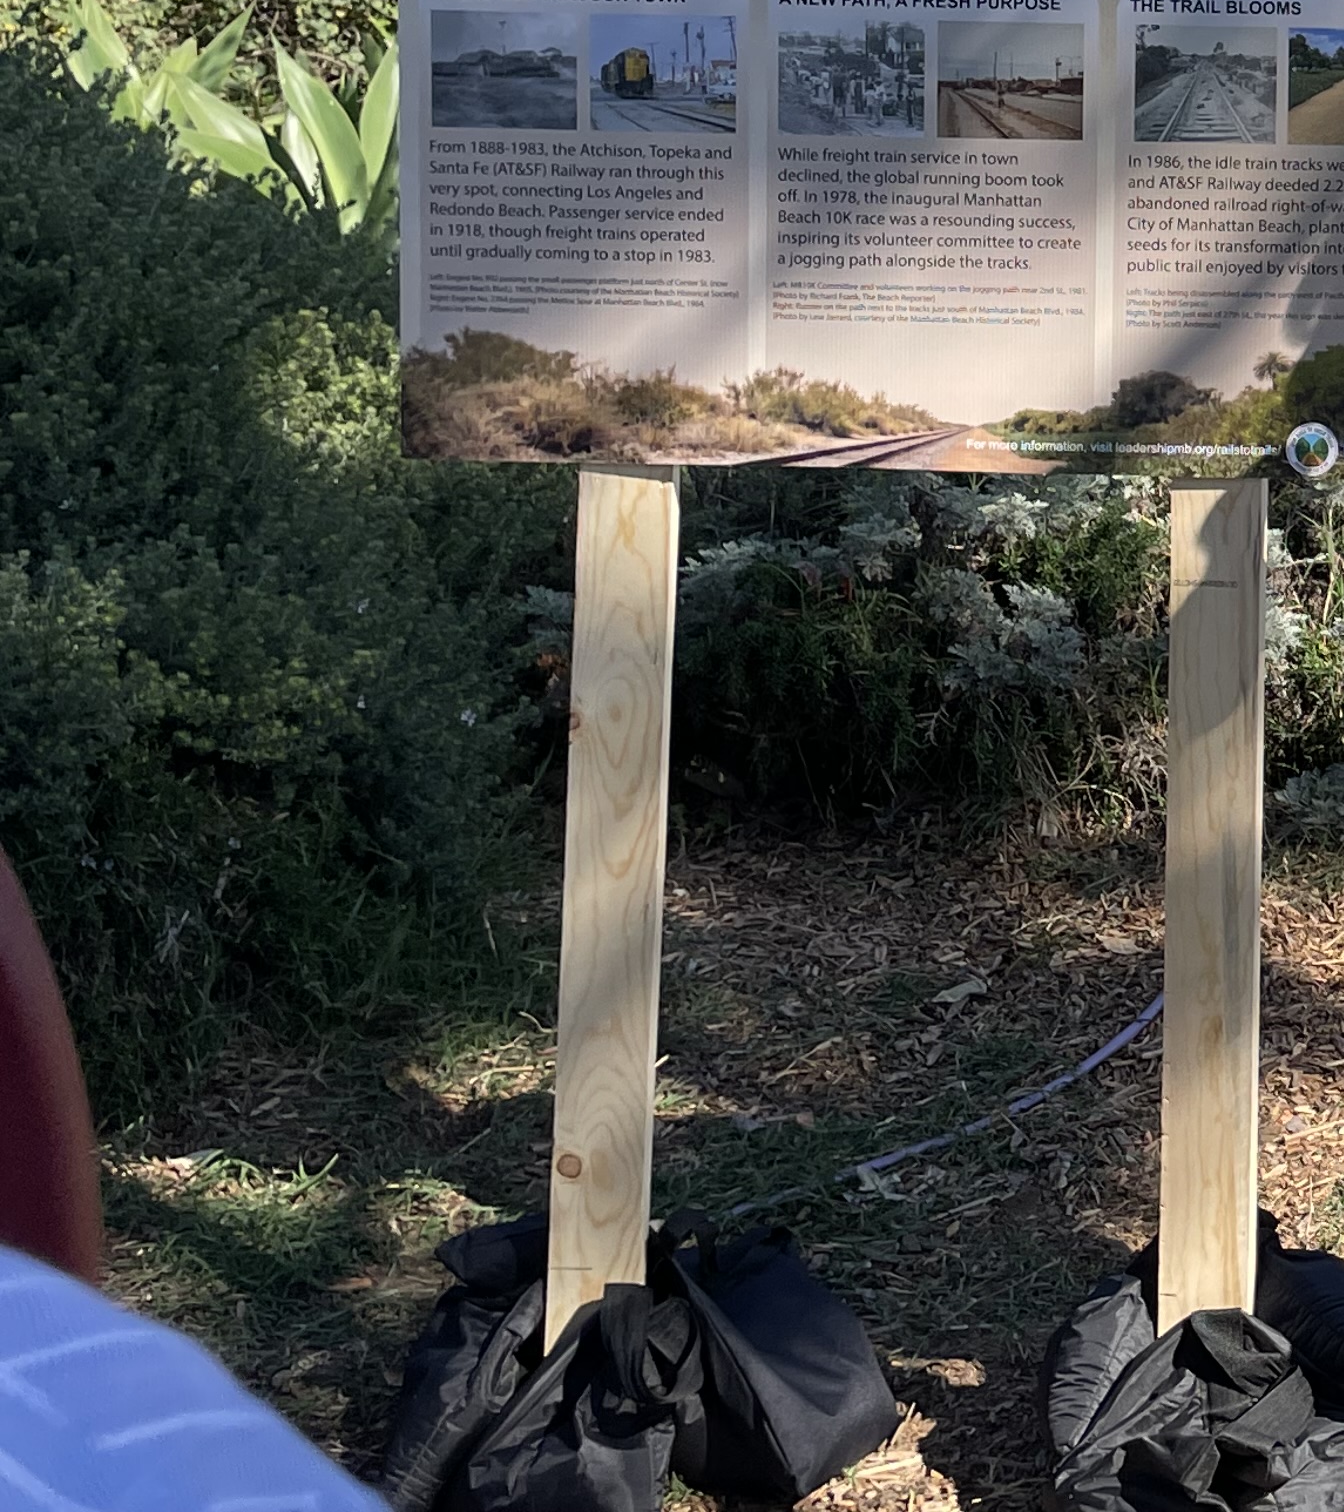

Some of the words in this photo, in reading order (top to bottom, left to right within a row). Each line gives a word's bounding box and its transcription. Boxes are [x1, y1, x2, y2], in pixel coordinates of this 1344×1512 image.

[1169, 0, 1220, 15] TRAIL
[1226, 0, 1301, 16] BLOOMS
[429, 140, 466, 155] From
[552, 142, 576, 157] the
[579, 143, 646, 160] Atchison,
[648, 144, 700, 162] Topeka
[704, 145, 732, 160] and
[777, 147, 818, 162] While
[822, 148, 870, 166] freight
[873, 149, 906, 163] train
[910, 149, 960, 164] service
[964, 150, 978, 164] in
[981, 152, 1018, 165] town
[429, 160, 468, 175] Santa
[473, 161, 489, 175] Fe
[492, 162, 547, 180] (AT&SF)
[550, 163, 606, 181] Railway
[608, 167, 632, 178] ran
[636, 164, 694, 183] through
[698, 165, 724, 180] this
[1128, 154, 1141, 168] In
[1146, 154, 1184, 171] 1986,
[1187, 155, 1211, 169] the
[1215, 155, 1241, 170] idle
[1244, 156, 1277, 170] train
[1280, 156, 1323, 171] tracks
[777, 168, 842, 185] declined,
[846, 169, 870, 183] the
[873, 169, 919, 188] global
[923, 170, 980, 189] running
[984, 171, 1027, 186] boom
[1030, 172, 1064, 186] took
[1127, 174, 1155, 189] and
[1158, 175, 1203, 190] AT&SF
[1207, 176, 1262, 194] Railway
[1264, 177, 1319, 191] deeded
[1322, 178, 1344, 192] 2.2
[428, 185, 460, 199] very
[464, 182, 498, 200] spot,
[502, 182, 582, 201] connecting
[586, 184, 610, 198] Los
[614, 184, 672, 203] Angeles
[675, 186, 703, 200] and
[777, 188, 800, 203] off.
[804, 189, 817, 203] In
[822, 189, 860, 206] 1978,
[864, 190, 888, 204] the
[891, 190, 959, 209] inaugural
[963, 191, 1042, 207] Manhattan
[430, 201, 494, 217] Redondo
[498, 203, 545, 218] Beach.
[548, 204, 621, 223] Passenger
[624, 205, 674, 220] service
[677, 206, 724, 221] ended
[1127, 195, 1209, 210] abandoned
[1213, 196, 1267, 211] railroad
[778, 209, 820, 224] Beach
[826, 210, 852, 224] 10K
[855, 214, 885, 225] race
[888, 214, 916, 225] was
[920, 215, 928, 225] a
[932, 211, 1014, 230] resounding
[1018, 217, 1075, 230] success,
[1126, 215, 1156, 233] City
[1158, 216, 1174, 230] of
[1176, 216, 1254, 231] Manhattan
[1258, 218, 1305, 234] Beach,
[430, 222, 443, 236] in
[448, 222, 484, 239] 1918,
[488, 223, 541, 242] though
[545, 224, 592, 243] freight
[596, 225, 636, 240] trains
[639, 226, 704, 245] operated
[777, 229, 840, 248] inspiring
[844, 231, 860, 245] its
[863, 231, 933, 246] volunteer
[936, 232, 1014, 247] committee
[1018, 235, 1033, 248] to
[1036, 235, 1081, 249] create
[430, 243, 461, 257] until
[465, 243, 532, 262] gradually
[535, 245, 589, 263] coming
[593, 247, 608, 260] to
[611, 250, 620, 260] a
[623, 246, 656, 264] stop
[659, 247, 672, 261] in
[677, 247, 715, 262] 1983.
[1126, 236, 1167, 251] seeds
[1170, 237, 1191, 251] for
[1194, 237, 1211, 251] its
[1214, 237, 1320, 253] transformation
[777, 254, 785, 264] a
[788, 250, 844, 269] jogging
[848, 251, 882, 269] path
[885, 252, 956, 271] alongside
[959, 253, 983, 268] the
[987, 254, 1031, 268] tracks.
[1126, 257, 1171, 275] public
[1174, 257, 1202, 272] trail
[1205, 258, 1263, 276] enjoyed
[1266, 259, 1284, 277] by
[1286, 259, 1338, 274] visitors
[965, 439, 986, 450] For
[988, 441, 1018, 451] more
[1020, 440, 1087, 453] information,
[1090, 440, 1113, 453] visit
